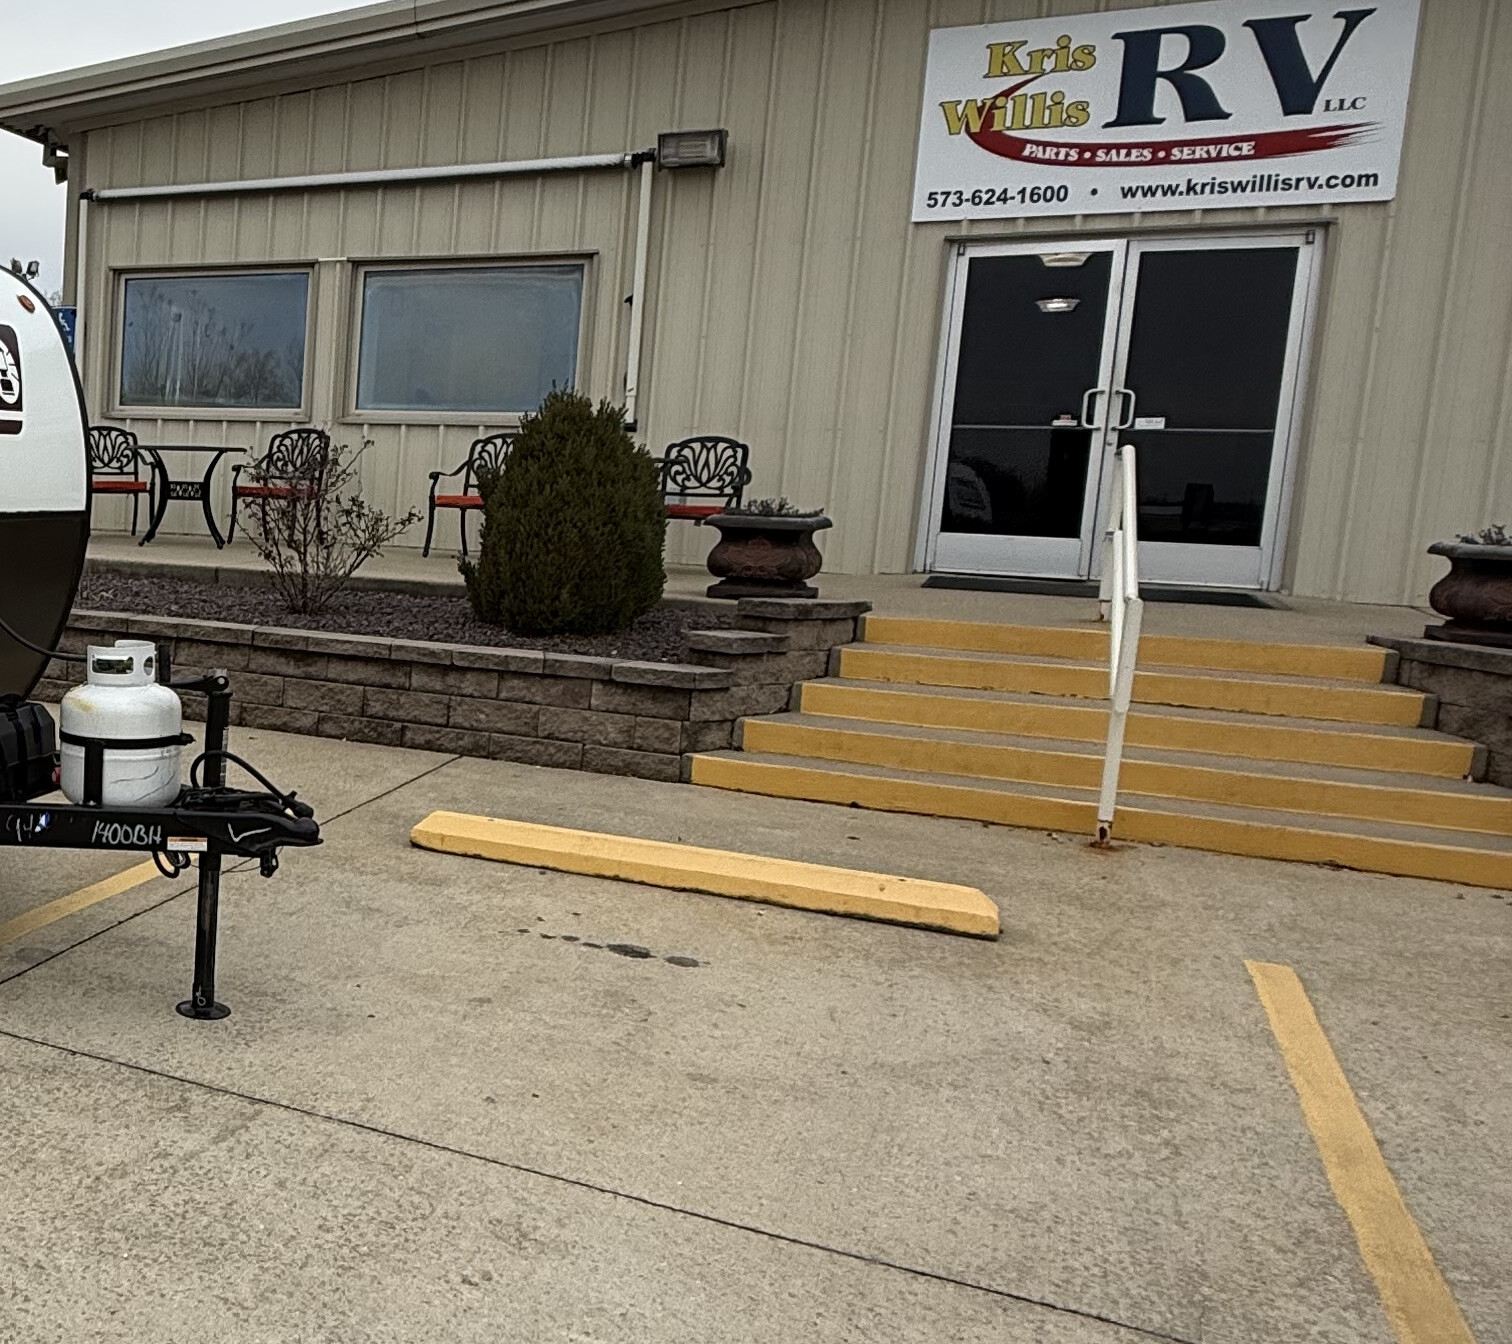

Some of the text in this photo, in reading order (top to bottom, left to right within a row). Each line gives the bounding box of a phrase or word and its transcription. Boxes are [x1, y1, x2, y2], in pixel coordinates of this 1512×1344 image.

[982, 34, 1097, 79] Kris
[1101, 8, 1378, 129] RV LLC
[939, 90, 1091, 135] Willis
[1022, 141, 1256, 162] PARTS SALES SERVICE
[926, 172, 1379, 209] 573-624-1600 www.kriswillisrv.com
[91, 820, 162, 845] 1400BH
